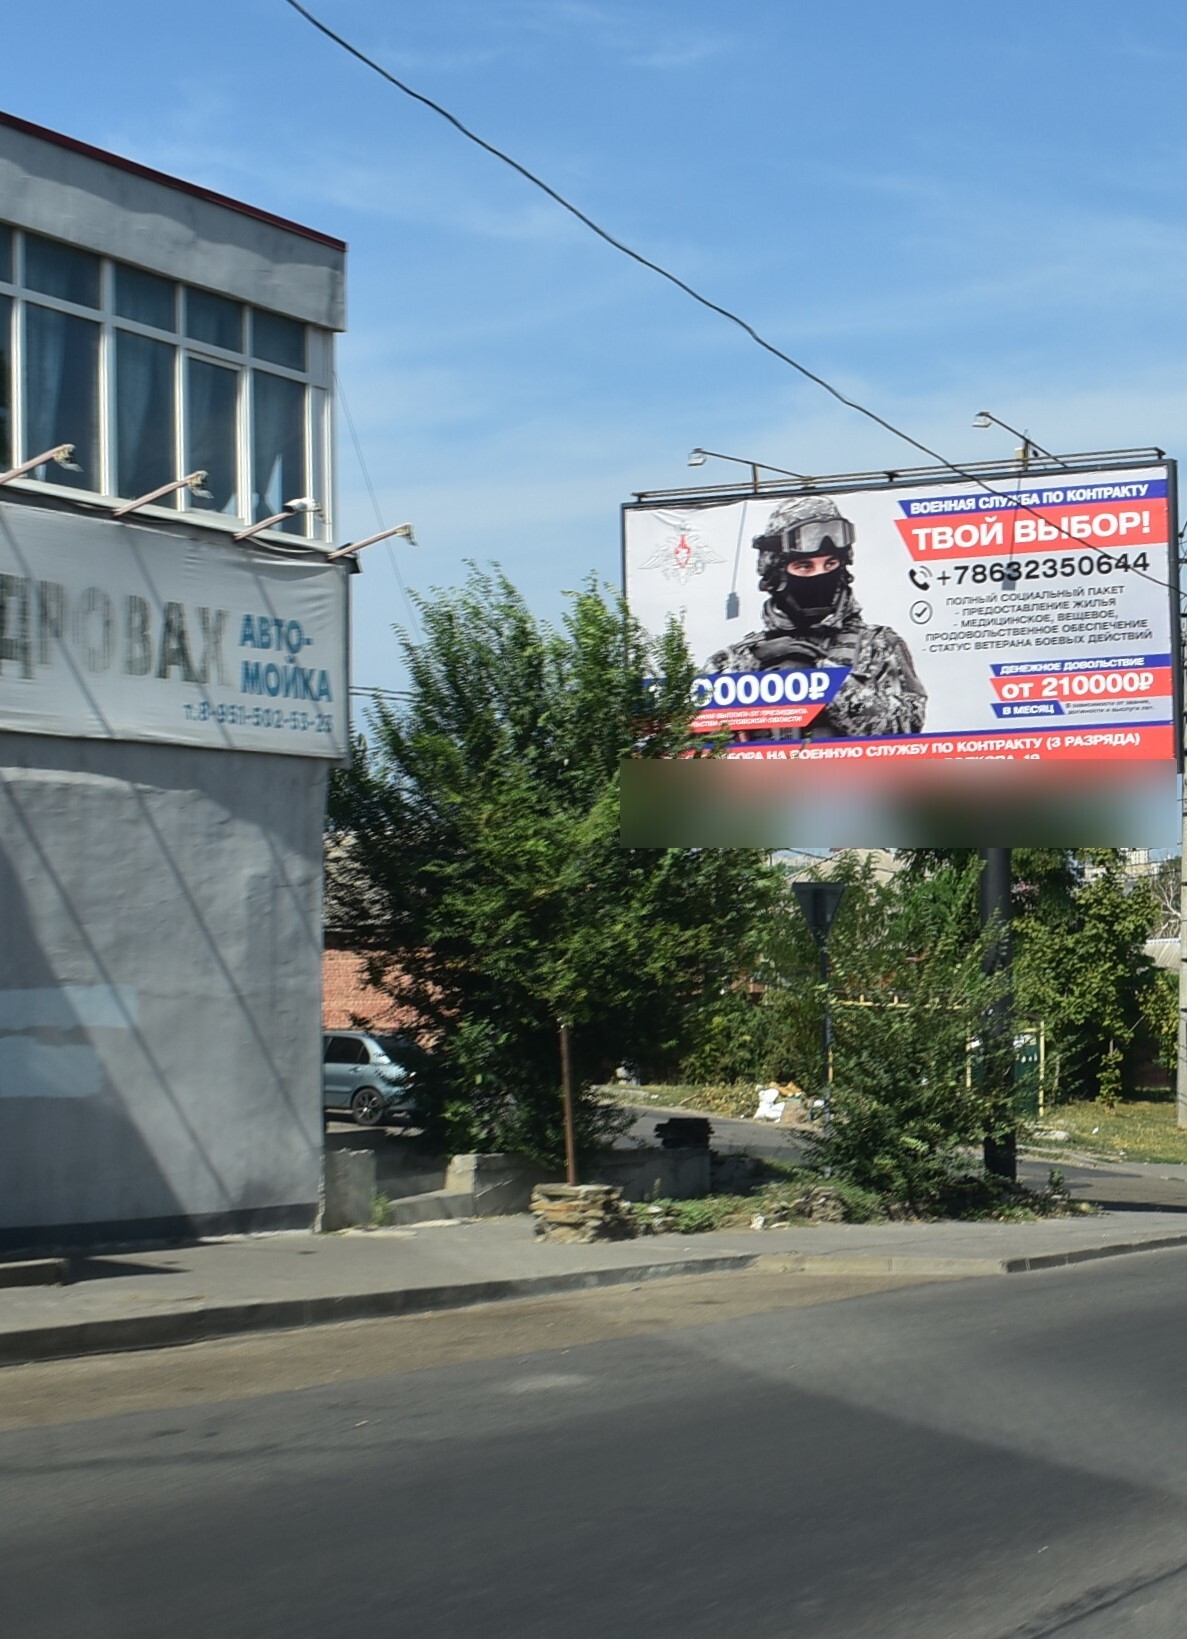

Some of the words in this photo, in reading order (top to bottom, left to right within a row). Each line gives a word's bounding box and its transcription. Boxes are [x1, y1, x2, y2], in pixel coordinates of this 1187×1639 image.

[910, 497, 976, 515] ВОЕННАЯ
[979, 492, 1040, 509] СЛУЖБА
[1043, 489, 1064, 504] ПО
[1067, 484, 1149, 502] КОНТРАКТУ
[912, 515, 1004, 551] ТВОЙ
[1014, 510, 1151, 544] ВЫБОР!
[937, 552, 1150, 586] +78632350644
[946, 593, 998, 607] ПОЛНЫЙ
[1000, 587, 1086, 602] СОЦИАЛЬНЫЙ
[1088, 585, 1126, 597] ПАКЕТ
[962, 601, 1070, 617] ПРЕДОСТАВЛЕНИЕ
[1073, 598, 1117, 609] ЖИЛЬЯ
[925, 624, 1060, 642] ПРОДОВОЛЬСТВЕННОЕ
[1062, 619, 1149, 633] ОБЕСПЕЧЕНИЕ
[960, 613, 1055, 629] МЕДИЦИНСКОЕ,
[1057, 609, 1119, 623] ВЕЩЕВОЕ,
[239, 613, 314, 655] АВТО-
[929, 642, 972, 653] СТАТУС
[974, 637, 1032, 650] ВЕТЕРАНА
[1034, 634, 1085, 647] БОЕВЫХ
[1088, 630, 1153, 644] ДЕЙСТВИЙ
[1000, 662, 1061, 675] ДЕНЕЖНОЕ
[1063, 657, 1145, 672] ДОВОЛЬСТВИЕ
[240, 655, 334, 702] МОЙКА
[1002, 706, 1011, 715] В
[1013, 704, 1055, 715] МЕСЯЦ
[865, 743, 928, 758] СЛУЖБУ
[932, 741, 954, 754] ПО
[957, 737, 1043, 753] КОНТРАКТУ
[1046, 736, 1061, 750] (3
[1064, 733, 1141, 747] РАЗРЯДА)
